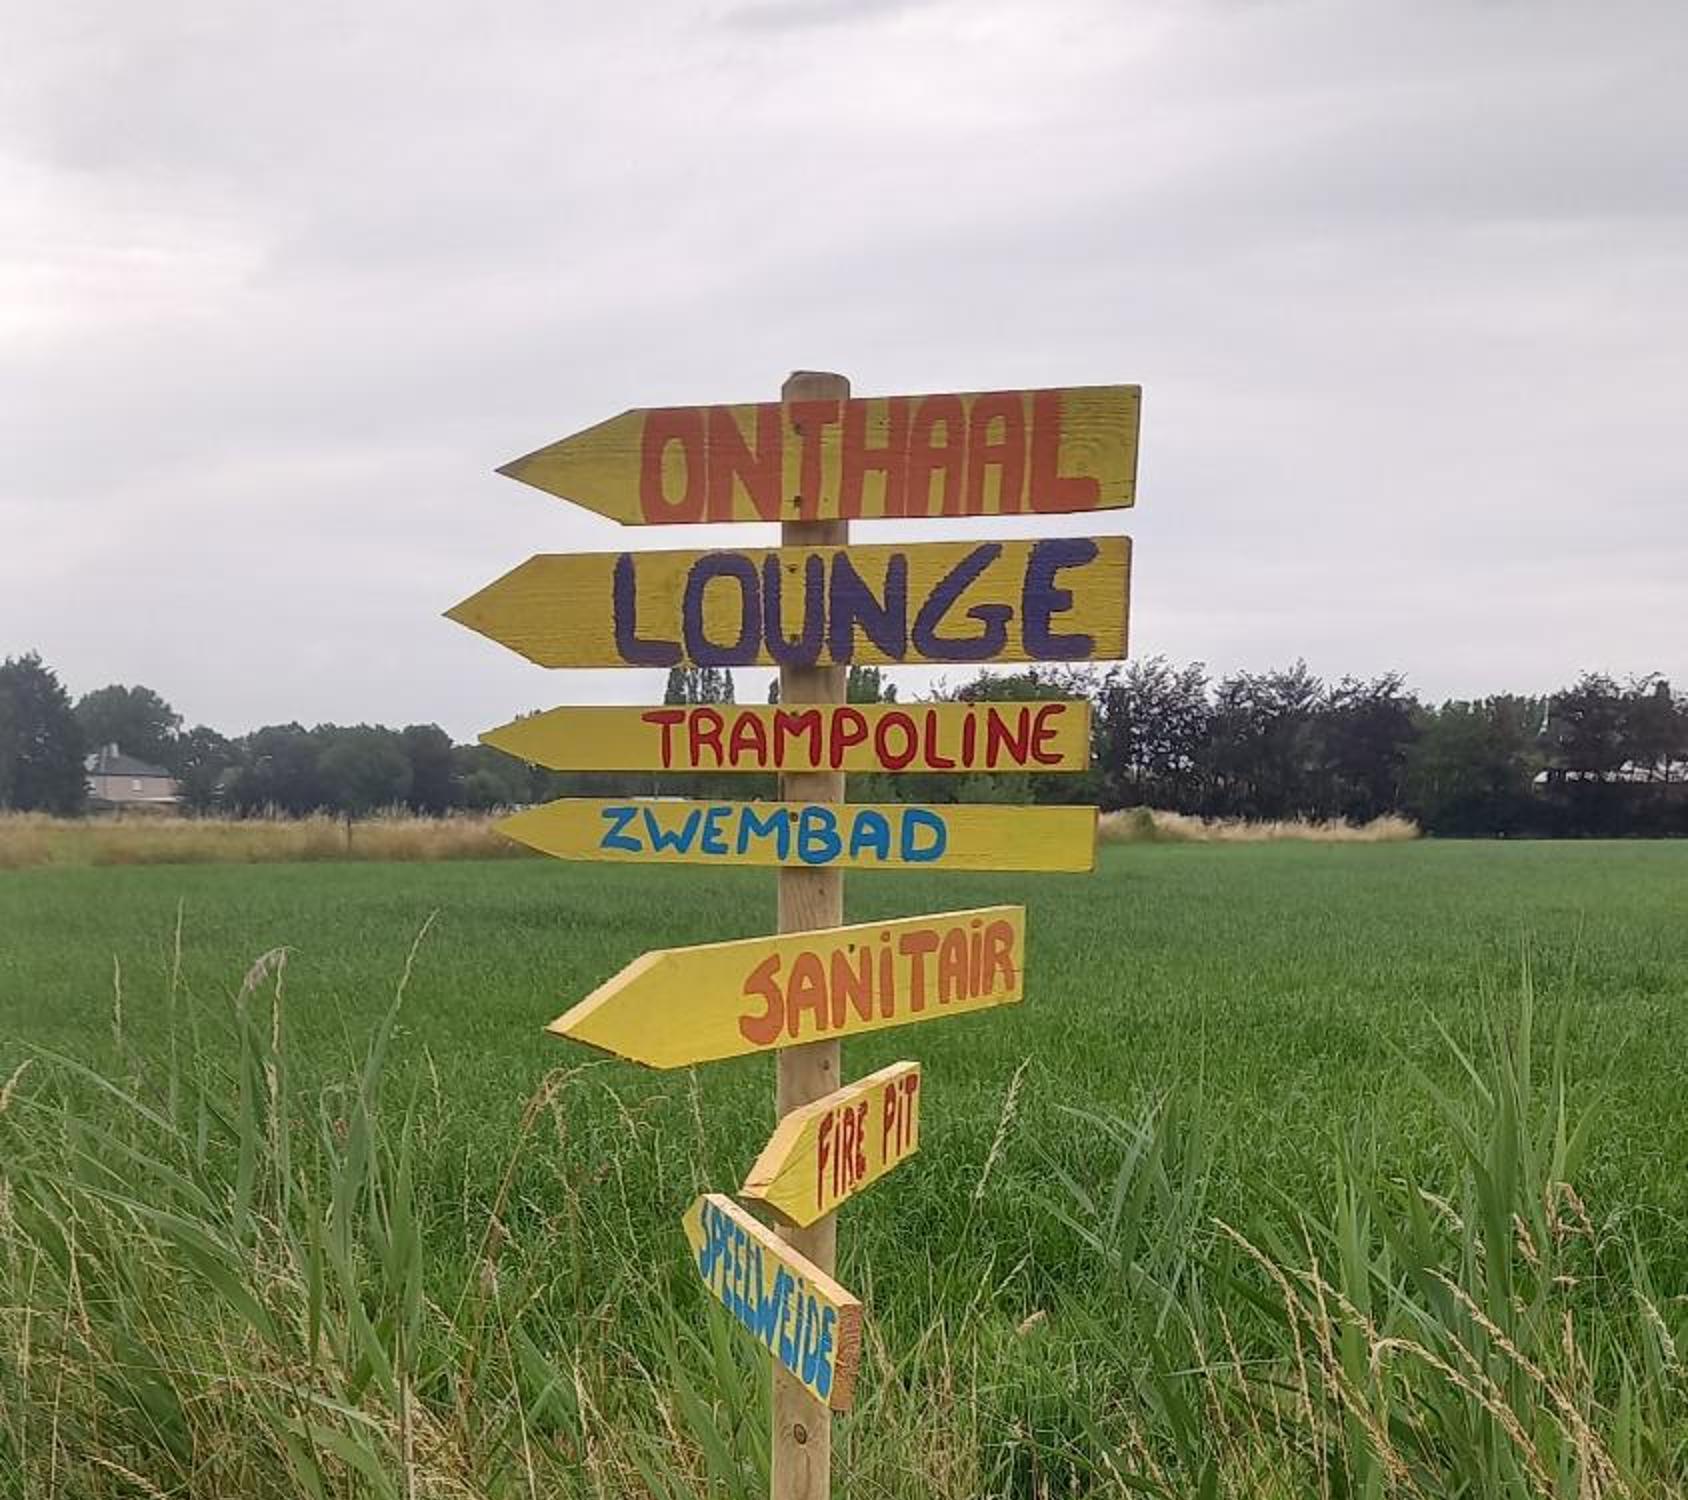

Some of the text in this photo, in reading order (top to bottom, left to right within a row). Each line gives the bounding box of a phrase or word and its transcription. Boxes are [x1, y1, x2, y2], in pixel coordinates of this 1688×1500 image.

[641, 392, 1098, 524] ONTHAAL
[612, 539, 1098, 666] LOUNGE
[600, 807, 947, 863] ZWEMBAD
